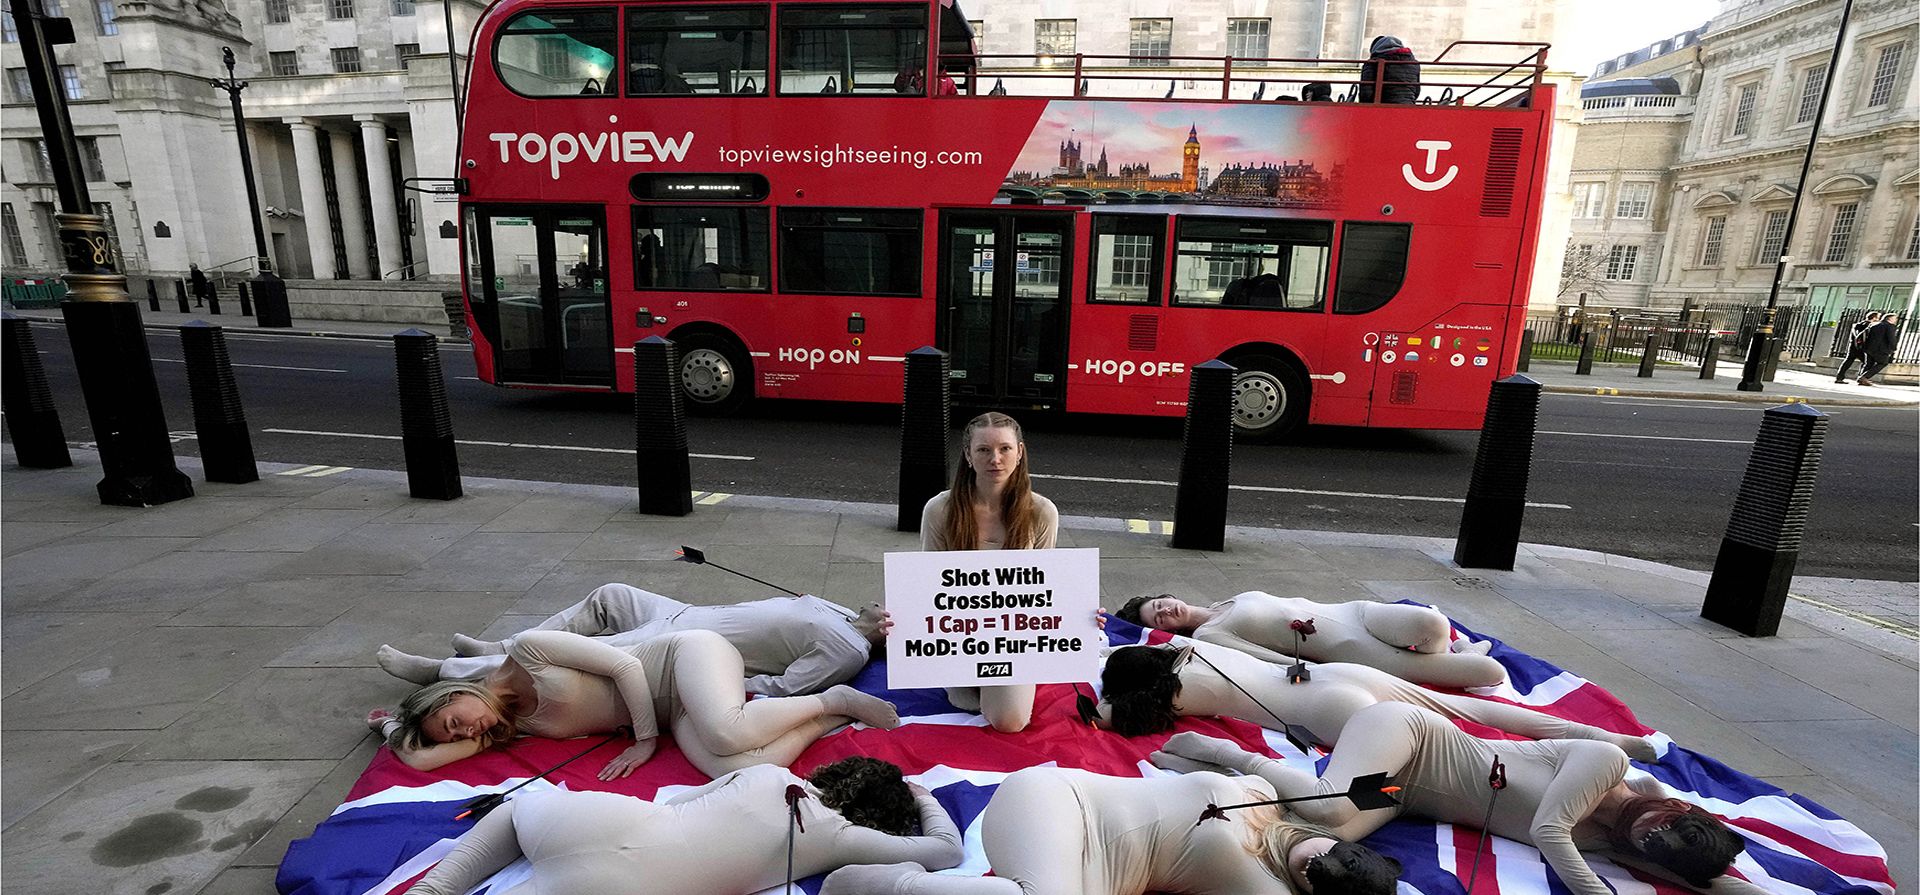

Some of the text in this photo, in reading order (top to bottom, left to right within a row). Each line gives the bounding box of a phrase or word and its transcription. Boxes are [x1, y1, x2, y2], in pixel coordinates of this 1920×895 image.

[718, 143, 983, 169] topviewsightseeing.com
[829, 349, 860, 365] ON
[1140, 361, 1185, 377] OFF
[941, 566, 1045, 587] Shot With
[934, 590, 1053, 610] Crossbows!
[925, 613, 1063, 635] 1 Cap = 1 Bear
[905, 635, 1082, 657] MoD: Go Fur-Free
